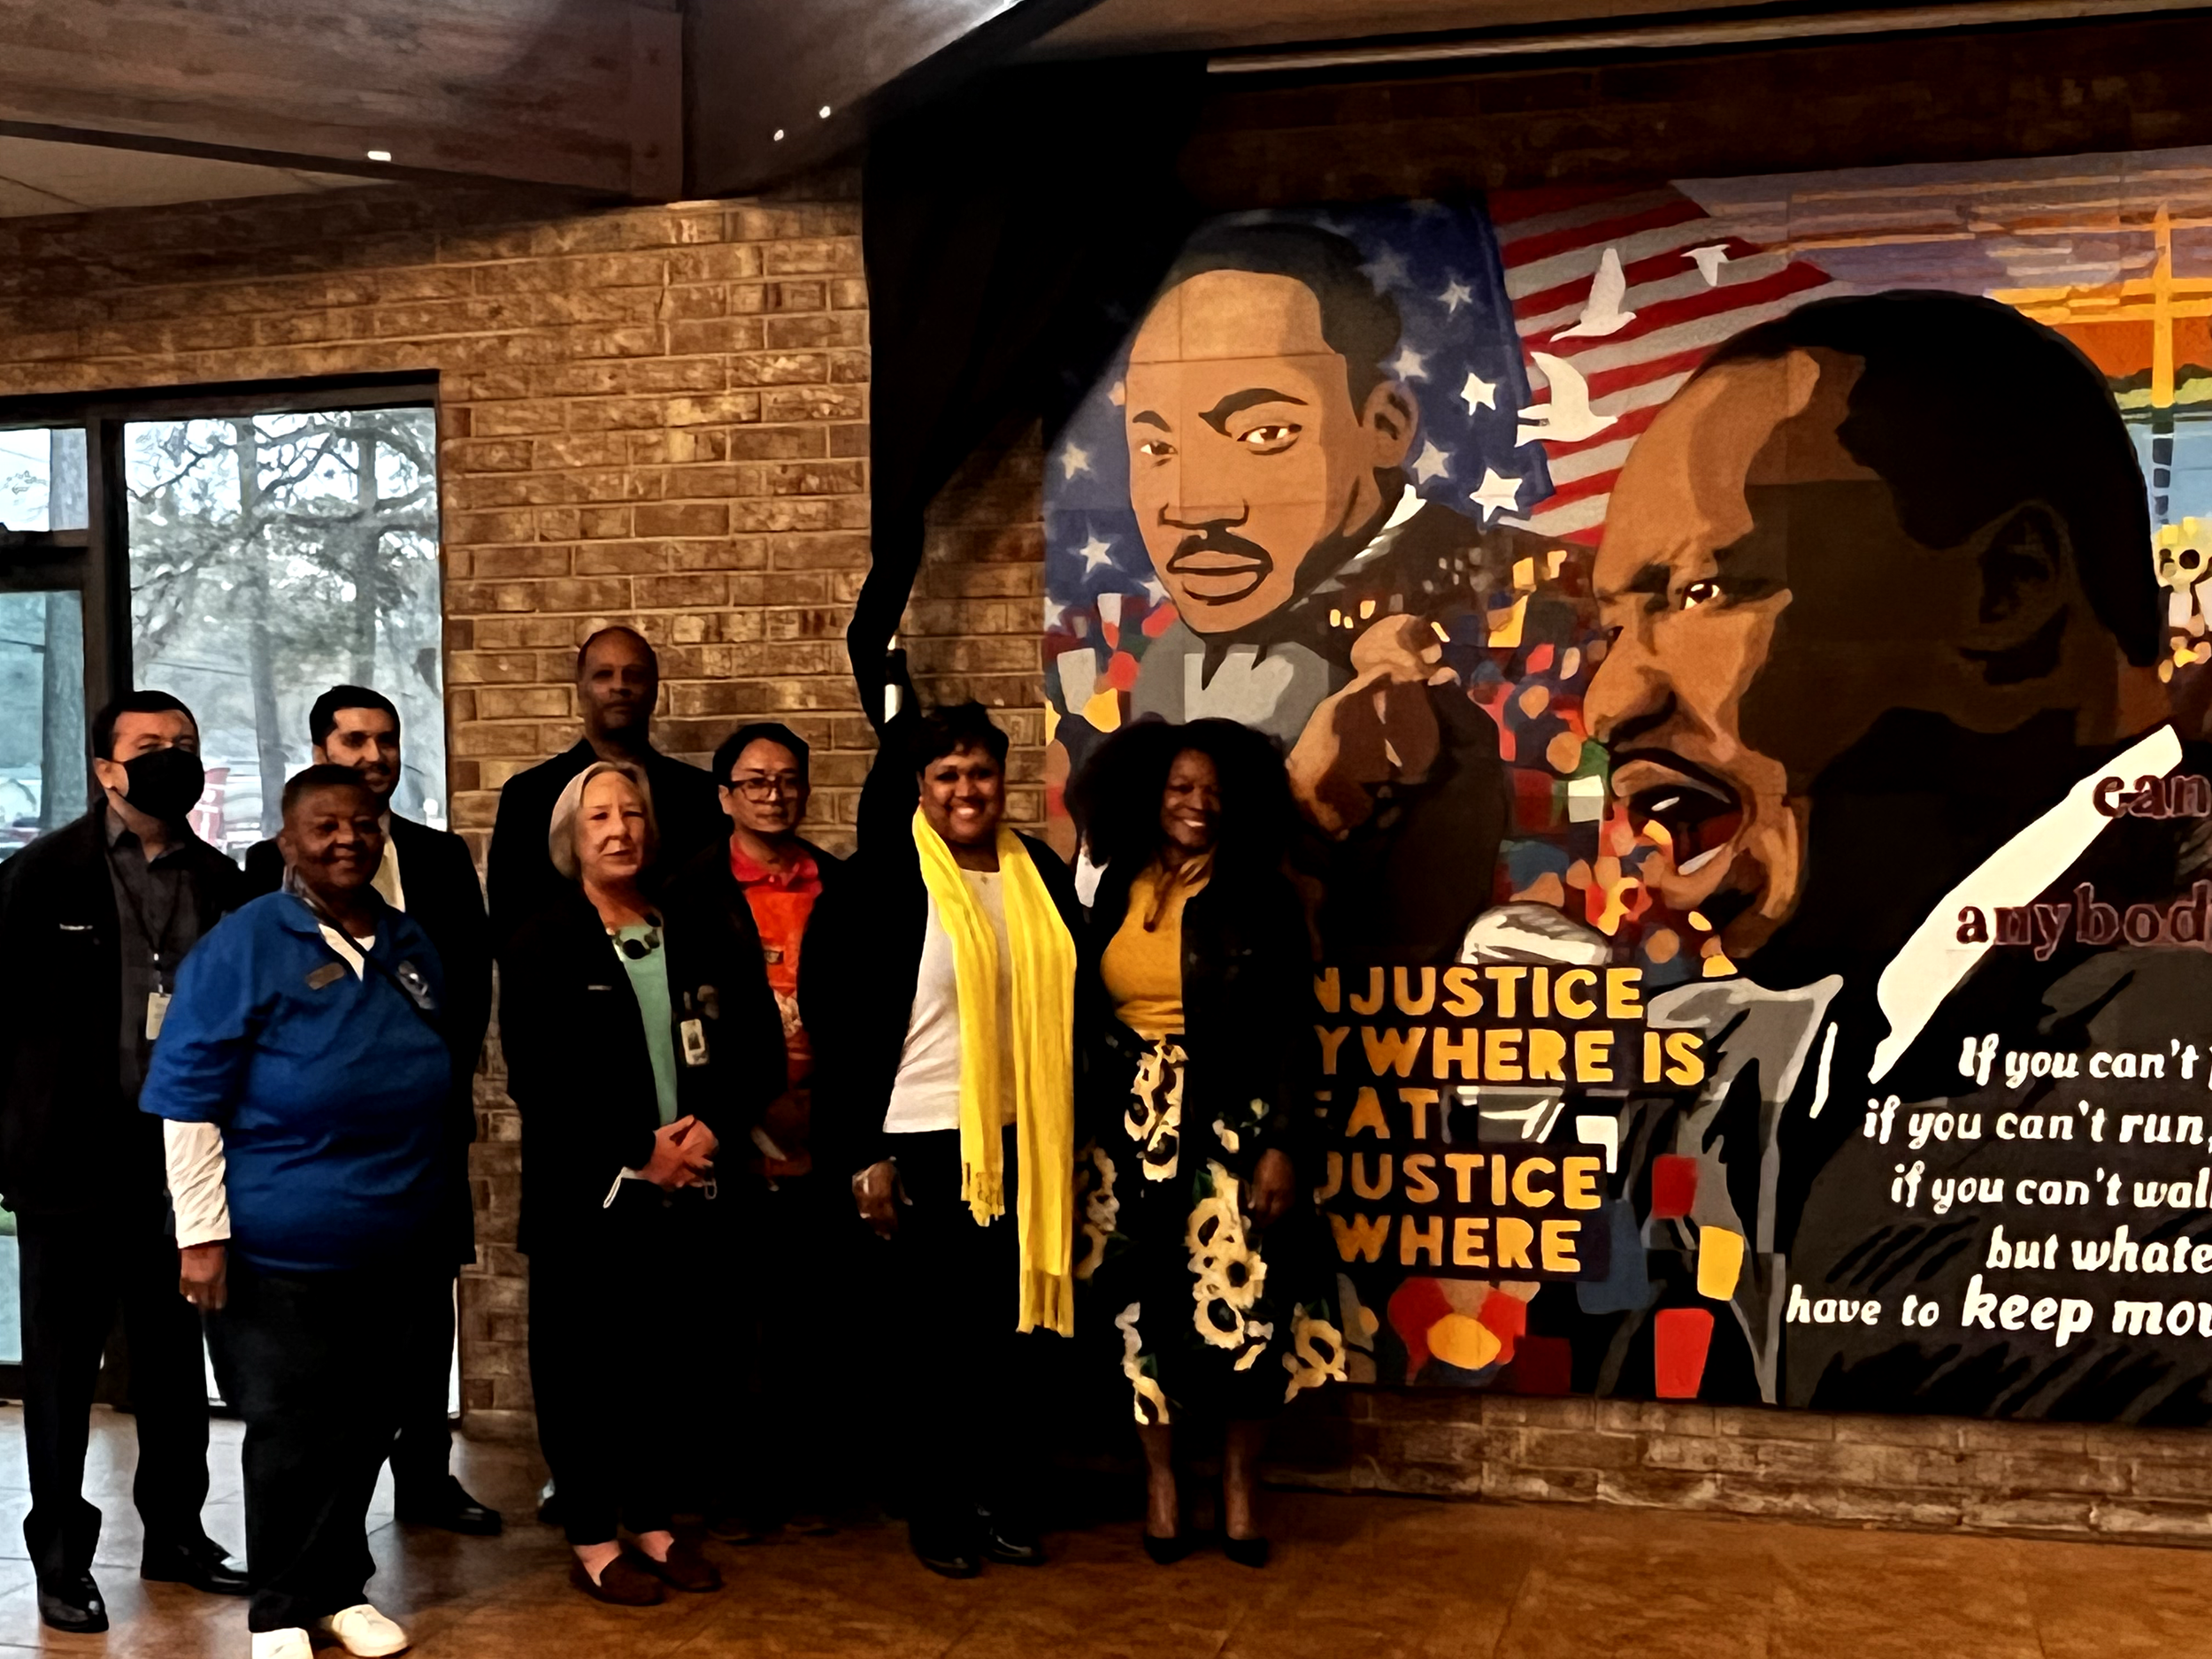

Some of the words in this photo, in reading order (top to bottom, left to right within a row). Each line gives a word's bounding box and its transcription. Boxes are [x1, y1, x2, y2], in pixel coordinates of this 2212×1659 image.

[2092, 773, 2212, 819] can
[1955, 878, 2212, 961] anybod
[1642, 1030, 1706, 1086] IS
[1958, 1033, 2000, 1087] If
[2005, 1050, 2079, 1089] you
[2089, 1038, 2200, 1079] can't
[1313, 1085, 1440, 1140] AT
[1863, 1094, 1901, 1145] if
[1908, 1111, 1982, 1150] you
[1995, 1099, 2106, 1142] can't
[1891, 1160, 1925, 1208] if
[1931, 1177, 2005, 1215] you
[2016, 1167, 2123, 1207] can't
[2133, 1166, 2212, 1209] wal
[1327, 1211, 1582, 1273] WHERE
[1985, 1225, 2059, 1270] but
[1786, 1283, 1882, 1325] have
[1901, 1294, 1939, 1327] to
[1961, 1273, 2094, 1348] keep
